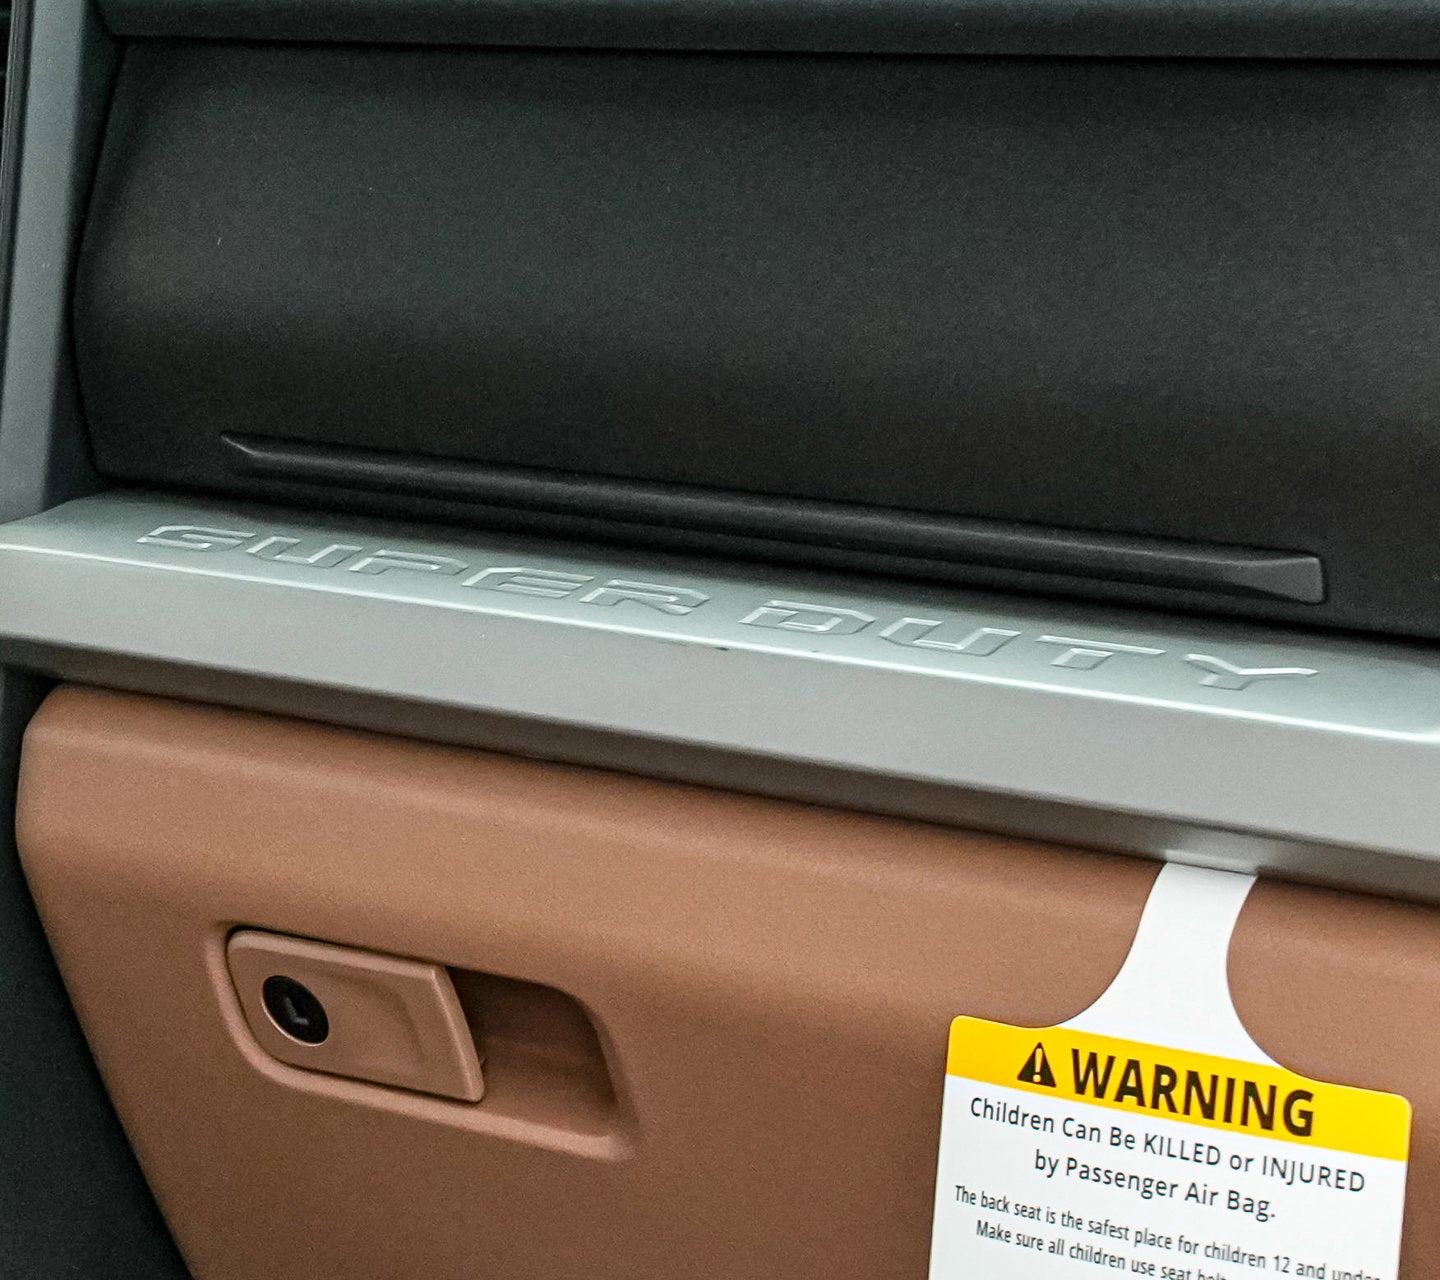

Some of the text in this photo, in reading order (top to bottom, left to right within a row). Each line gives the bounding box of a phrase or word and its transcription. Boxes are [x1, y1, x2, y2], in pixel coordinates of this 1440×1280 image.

[135, 524, 1320, 693] SUPER DUTY
[1071, 1048, 1315, 1137] WARNING
[970, 1096, 1365, 1193] Children Can Be KILLED or INJURED
[1034, 1148, 1276, 1223] by Passenger Air Bag.
[954, 1184, 977, 1206] The
[981, 1190, 1010, 1214] back
[1013, 1202, 1042, 1222] seat
[1045, 1206, 1057, 1225] is
[1060, 1211, 1084, 1231] the
[1087, 1219, 1131, 1242] safest
[1134, 1227, 1172, 1251] place
[1177, 1234, 1199, 1256] for
[1203, 1240, 1267, 1270] children
[1273, 1254, 1291, 1274] 12
[1295, 1262, 1327, 1280] and
[975, 1219, 1012, 1244] Make
[1015, 1232, 1044, 1252] sure
[1047, 1238, 1065, 1257] all
[1068, 1242, 1126, 1271] children
[1130, 1258, 1156, 1277] use
